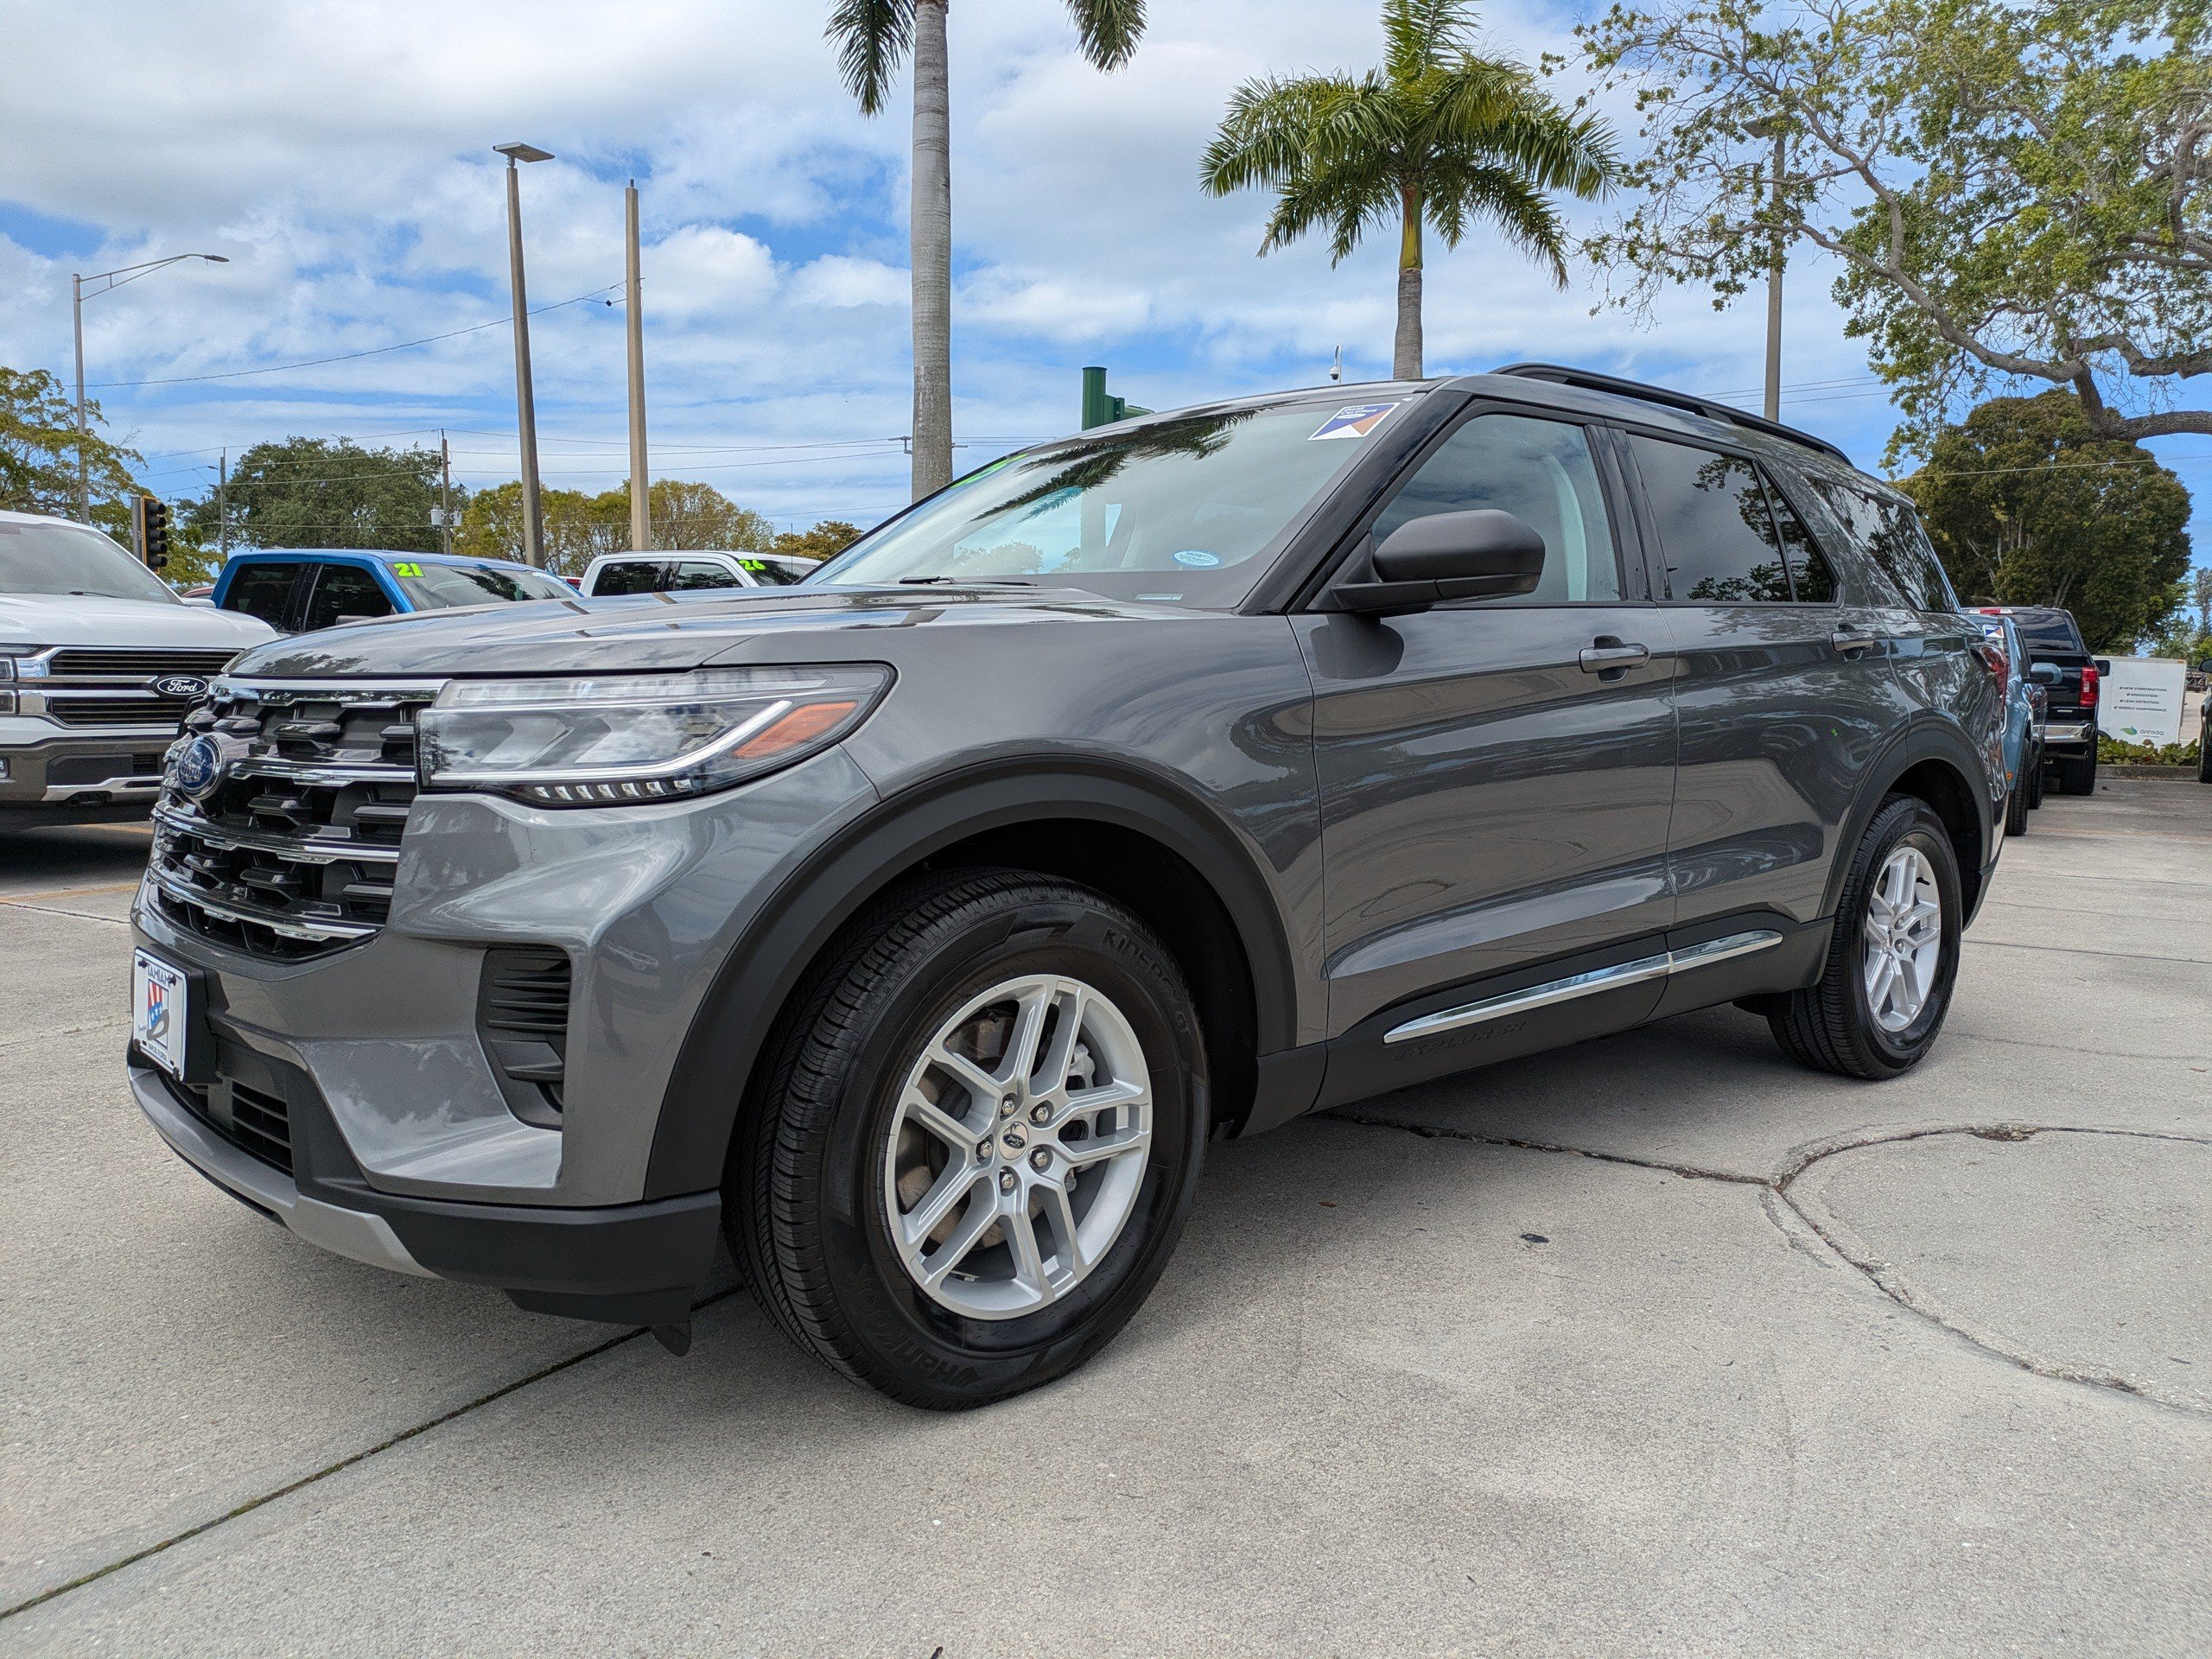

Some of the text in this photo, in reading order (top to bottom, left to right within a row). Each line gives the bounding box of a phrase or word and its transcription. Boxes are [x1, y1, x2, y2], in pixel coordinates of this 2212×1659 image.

[393, 563, 424, 578] 21
[738, 559, 766, 571] 26
[167, 679, 198, 692] Ford
[147, 963, 173, 988] TAMIAM
